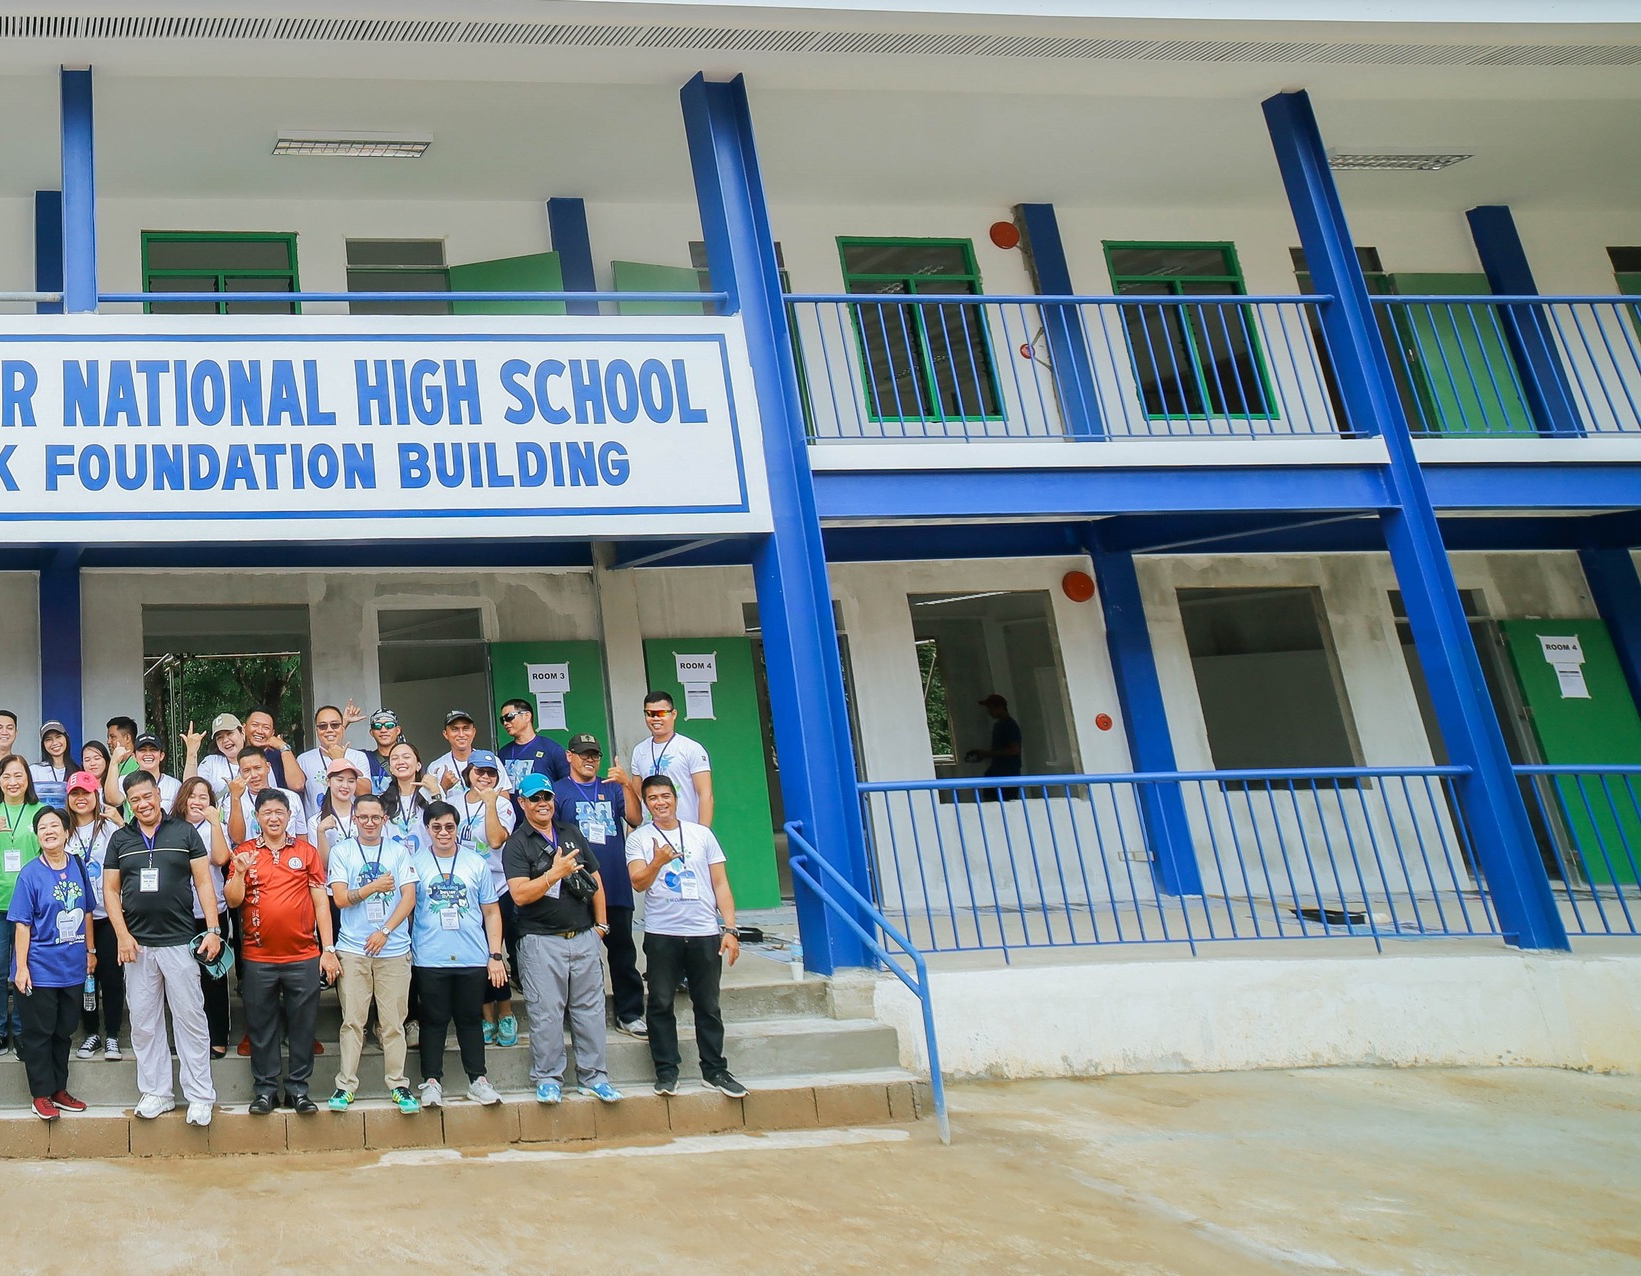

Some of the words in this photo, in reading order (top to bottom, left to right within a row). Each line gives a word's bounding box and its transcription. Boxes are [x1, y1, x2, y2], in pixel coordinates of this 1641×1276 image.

[62, 358, 337, 427] NATIONAL
[355, 358, 483, 426] HIGH
[500, 357, 708, 425] SCHOOL
[45, 443, 377, 492] FOUNDATION
[398, 441, 631, 489] BUILDING
[1544, 643, 1570, 651] ROOM
[679, 662, 705, 670] ROOM
[532, 672, 558, 680] ROOM
[559, 672, 565, 680] 3
